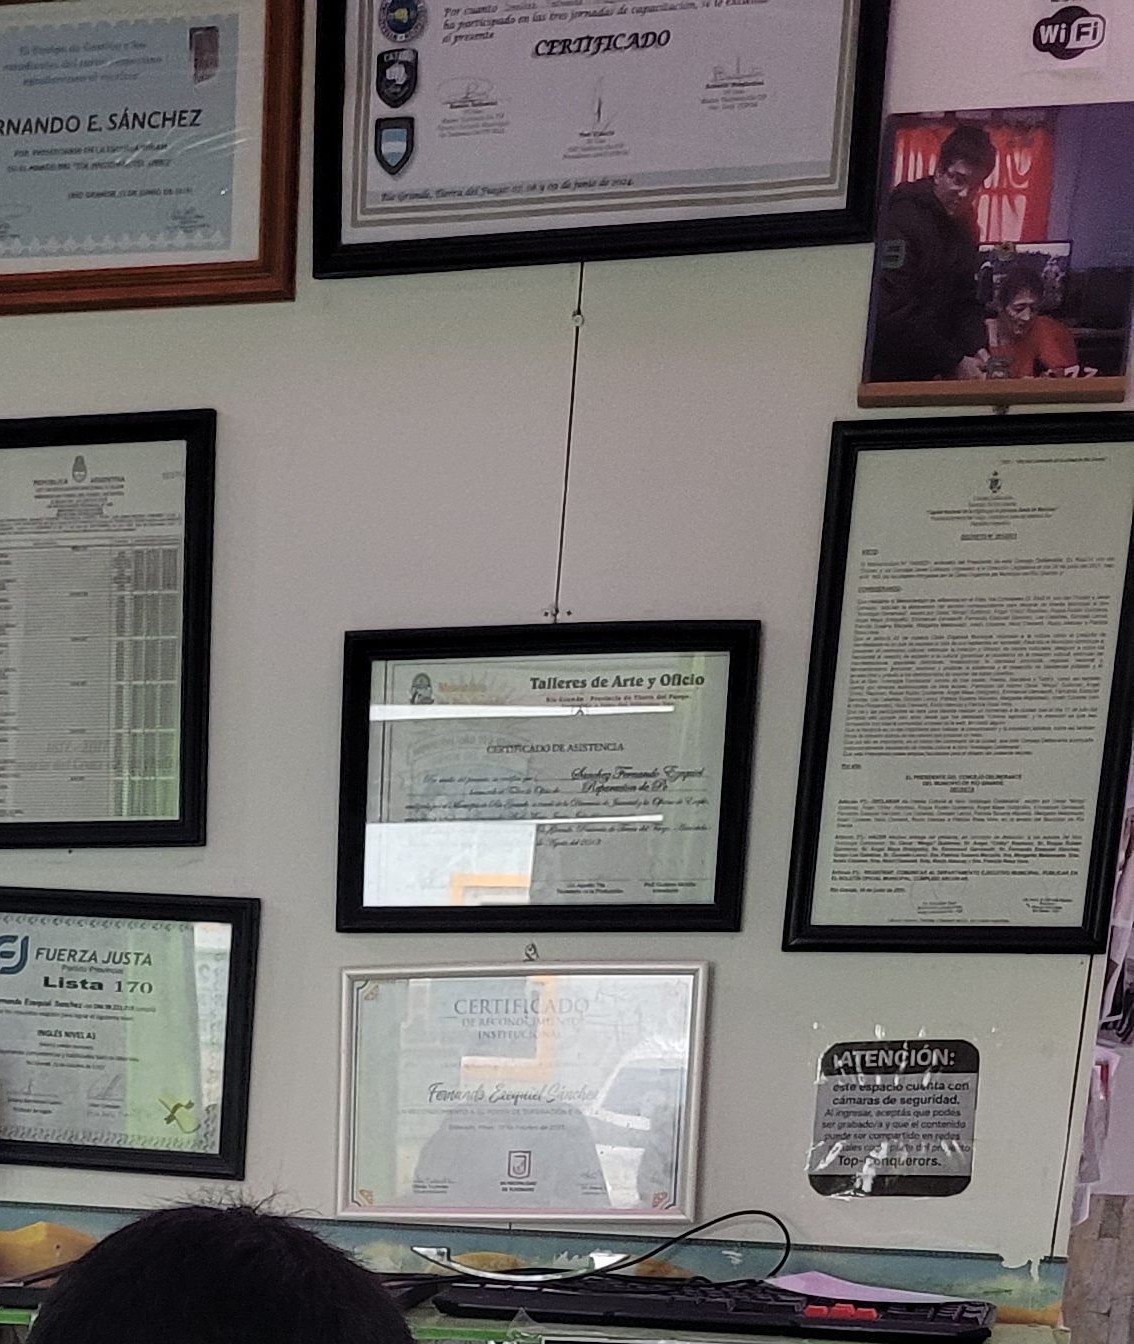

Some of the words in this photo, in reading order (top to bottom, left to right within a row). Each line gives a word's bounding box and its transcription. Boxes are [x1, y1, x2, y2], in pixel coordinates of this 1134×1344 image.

[532, 30, 672, 57] CERTIFICADO
[87, 114, 103, 132] E.
[108, 107, 203, 131] SÁNCHEZ
[529, 675, 587, 691] Talleres
[590, 675, 608, 689] de
[611, 673, 644, 689] Arte
[646, 677, 656, 691] y
[659, 672, 705, 688] Oficio
[486, 744, 550, 754] CERTIFICADO
[551, 743, 566, 752] DE
[567, 742, 624, 753] ASISTENCIA
[34, 947, 98, 964] FUERZA
[102, 951, 153, 967] JUSTA
[43, 976, 104, 992] Lista
[114, 980, 154, 994] 170
[453, 997, 591, 1018] CERTIFICADO
[427, 1081, 486, 1104] Fernando
[832, 1082, 857, 1091] este
[858, 1081, 904, 1094] espacio
[947, 1082, 970, 1091] con
[832, 1094, 880, 1105] cámaras
[881, 1095, 897, 1105] de
[899, 1095, 960, 1107] seguridad.
[824, 1109, 834, 1117] Al
[912, 1109, 931, 1118] que
[821, 1121, 835, 1129] ser
[884, 1121, 891, 1130] y
[892, 1122, 909, 1130] que
[910, 1120, 919, 1128] el
[920, 1120, 966, 1129] contenido
[823, 1133, 852, 1142] puede
[853, 1133, 867, 1141] ser
[868, 1132, 921, 1142] compartido
[921, 1133, 933, 1141] en
[934, 1132, 961, 1141] redes
